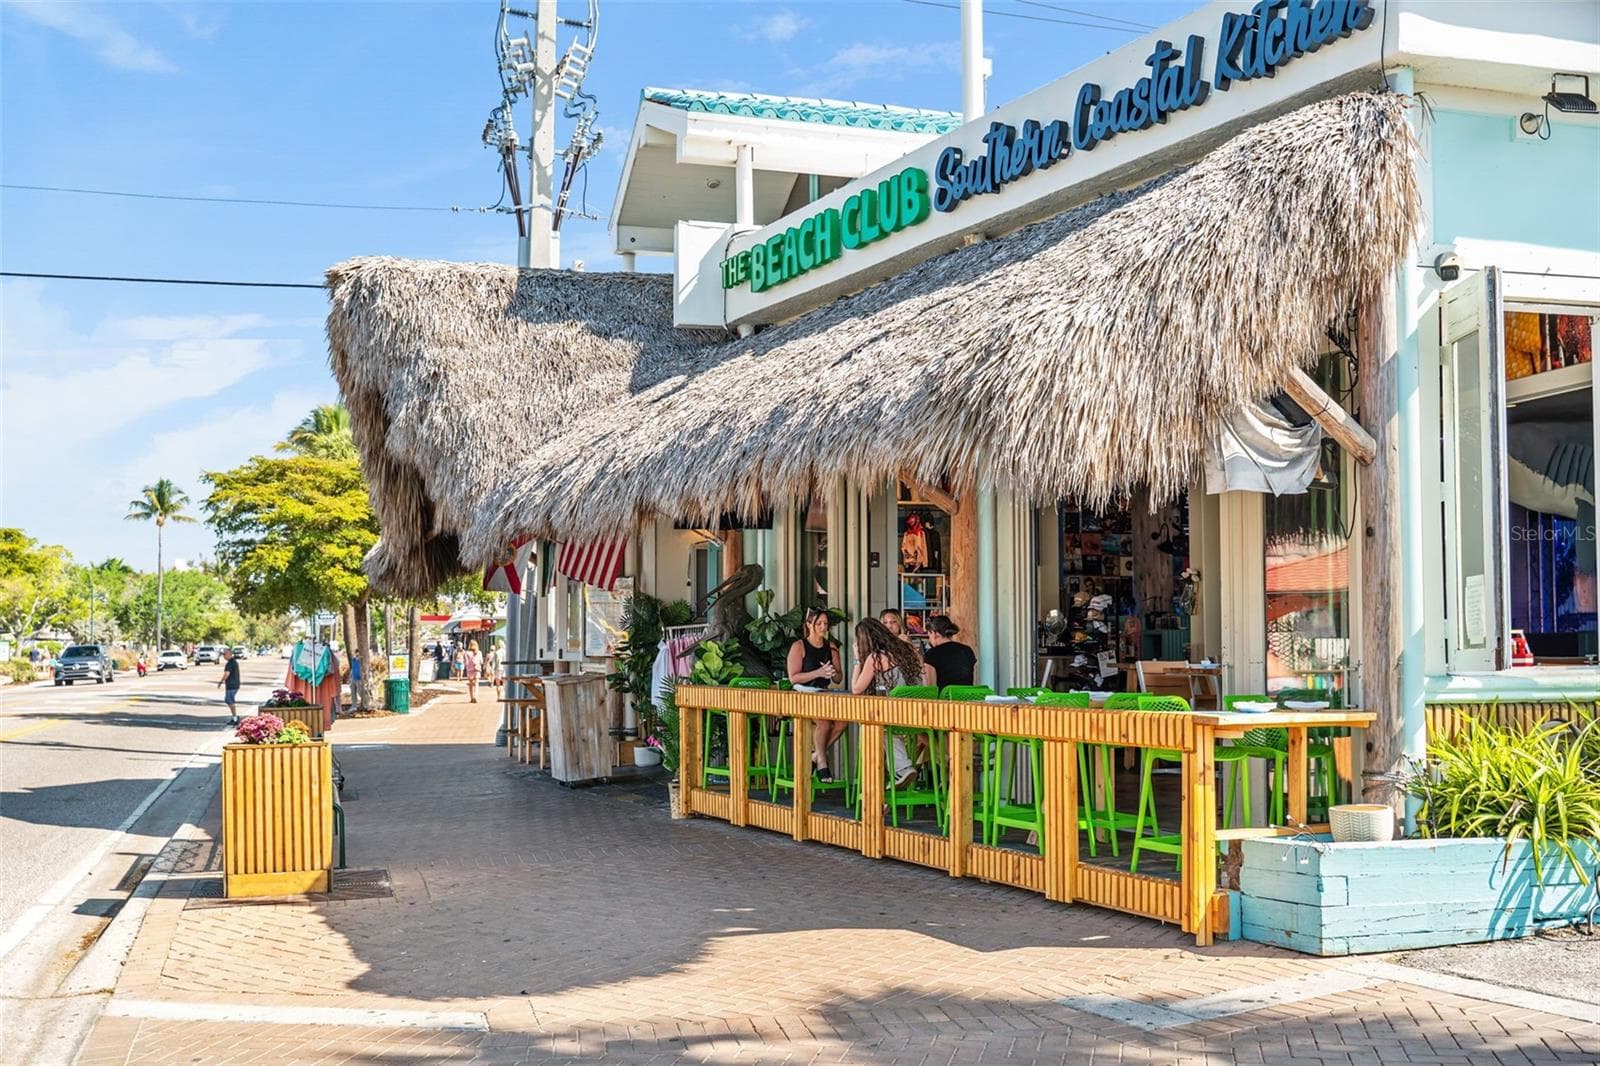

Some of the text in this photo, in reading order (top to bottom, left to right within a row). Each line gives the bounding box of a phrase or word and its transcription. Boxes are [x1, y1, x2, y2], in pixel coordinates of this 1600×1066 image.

[720, 0, 1375, 292] THE BEACH CLUB Southern Coastal Kitchen
